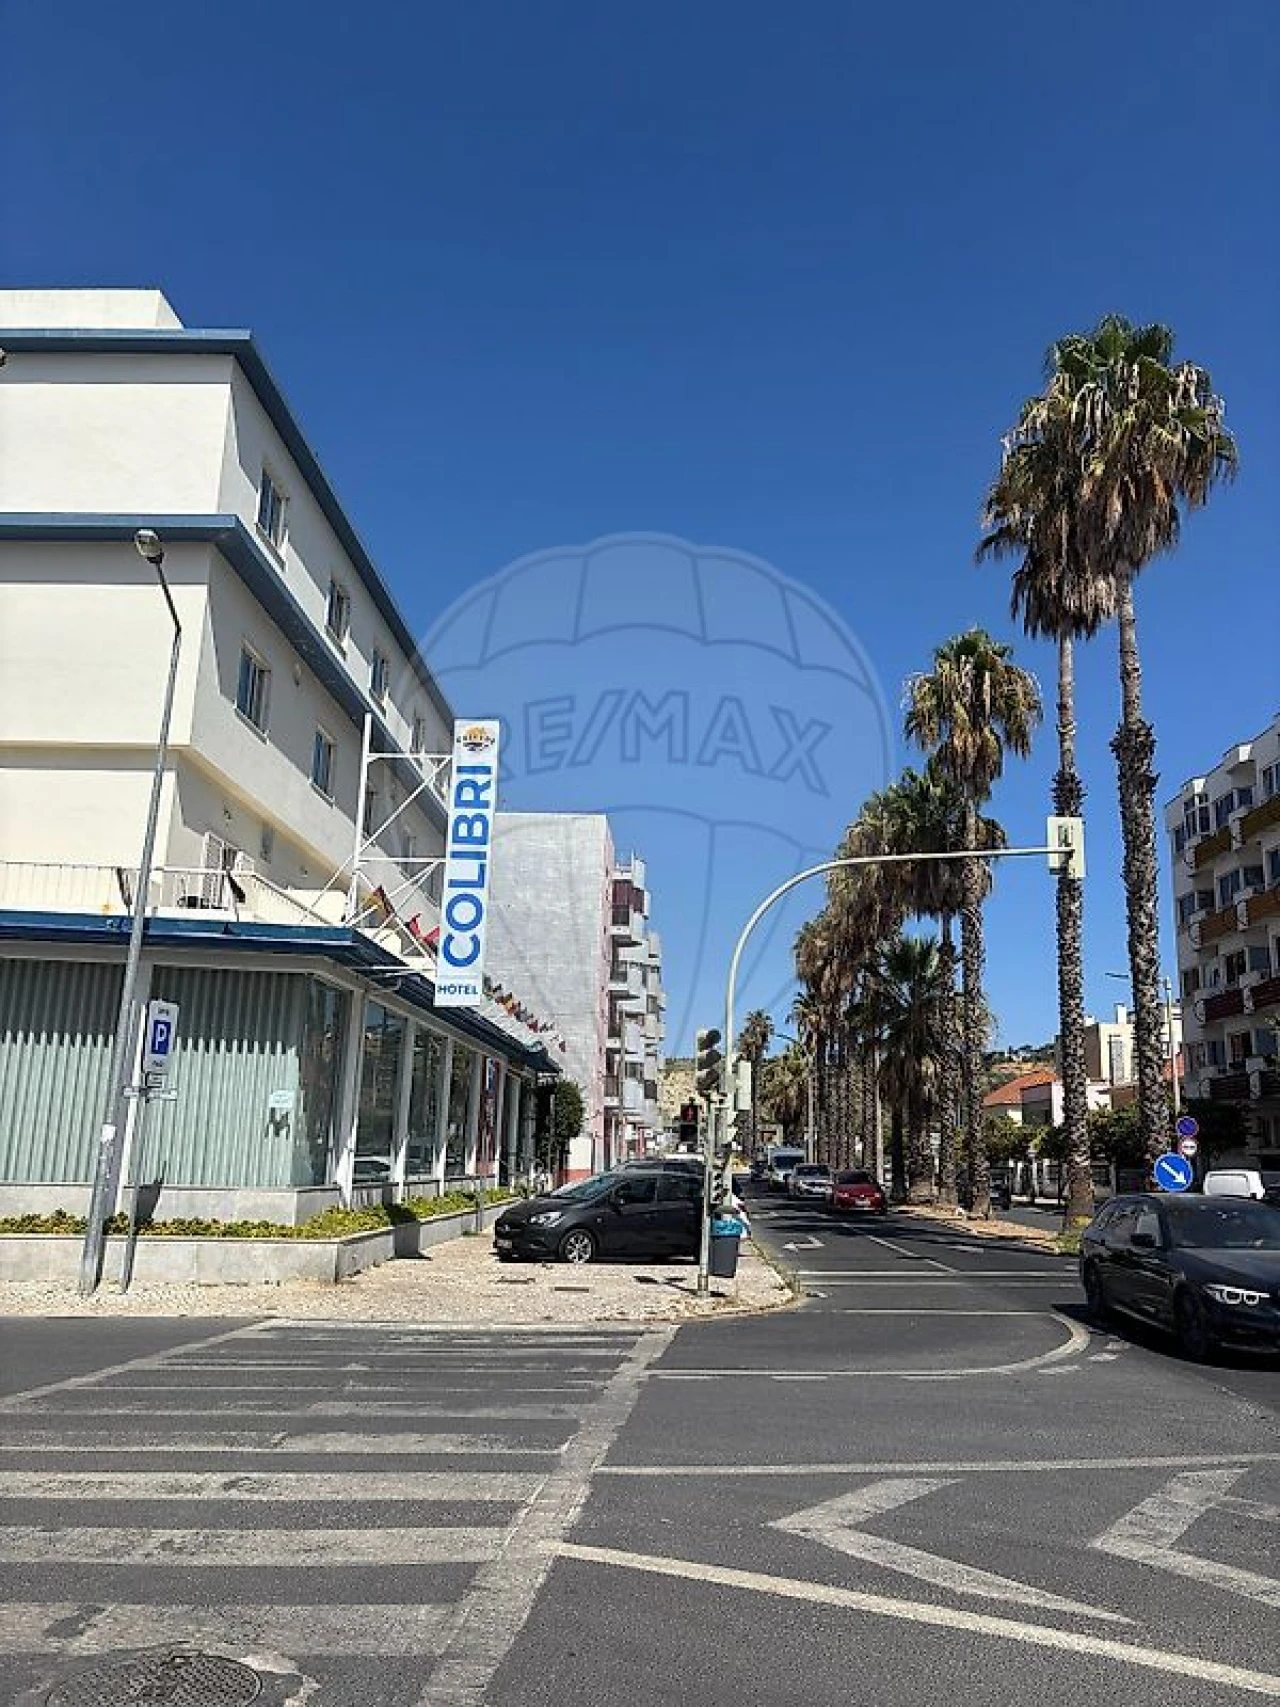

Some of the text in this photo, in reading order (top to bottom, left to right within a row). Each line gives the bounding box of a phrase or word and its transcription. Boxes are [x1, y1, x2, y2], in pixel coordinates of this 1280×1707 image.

[442, 765, 491, 967] COLIBRI
[437, 984, 478, 995] HOTEL
[155, 1023, 168, 1050] P
